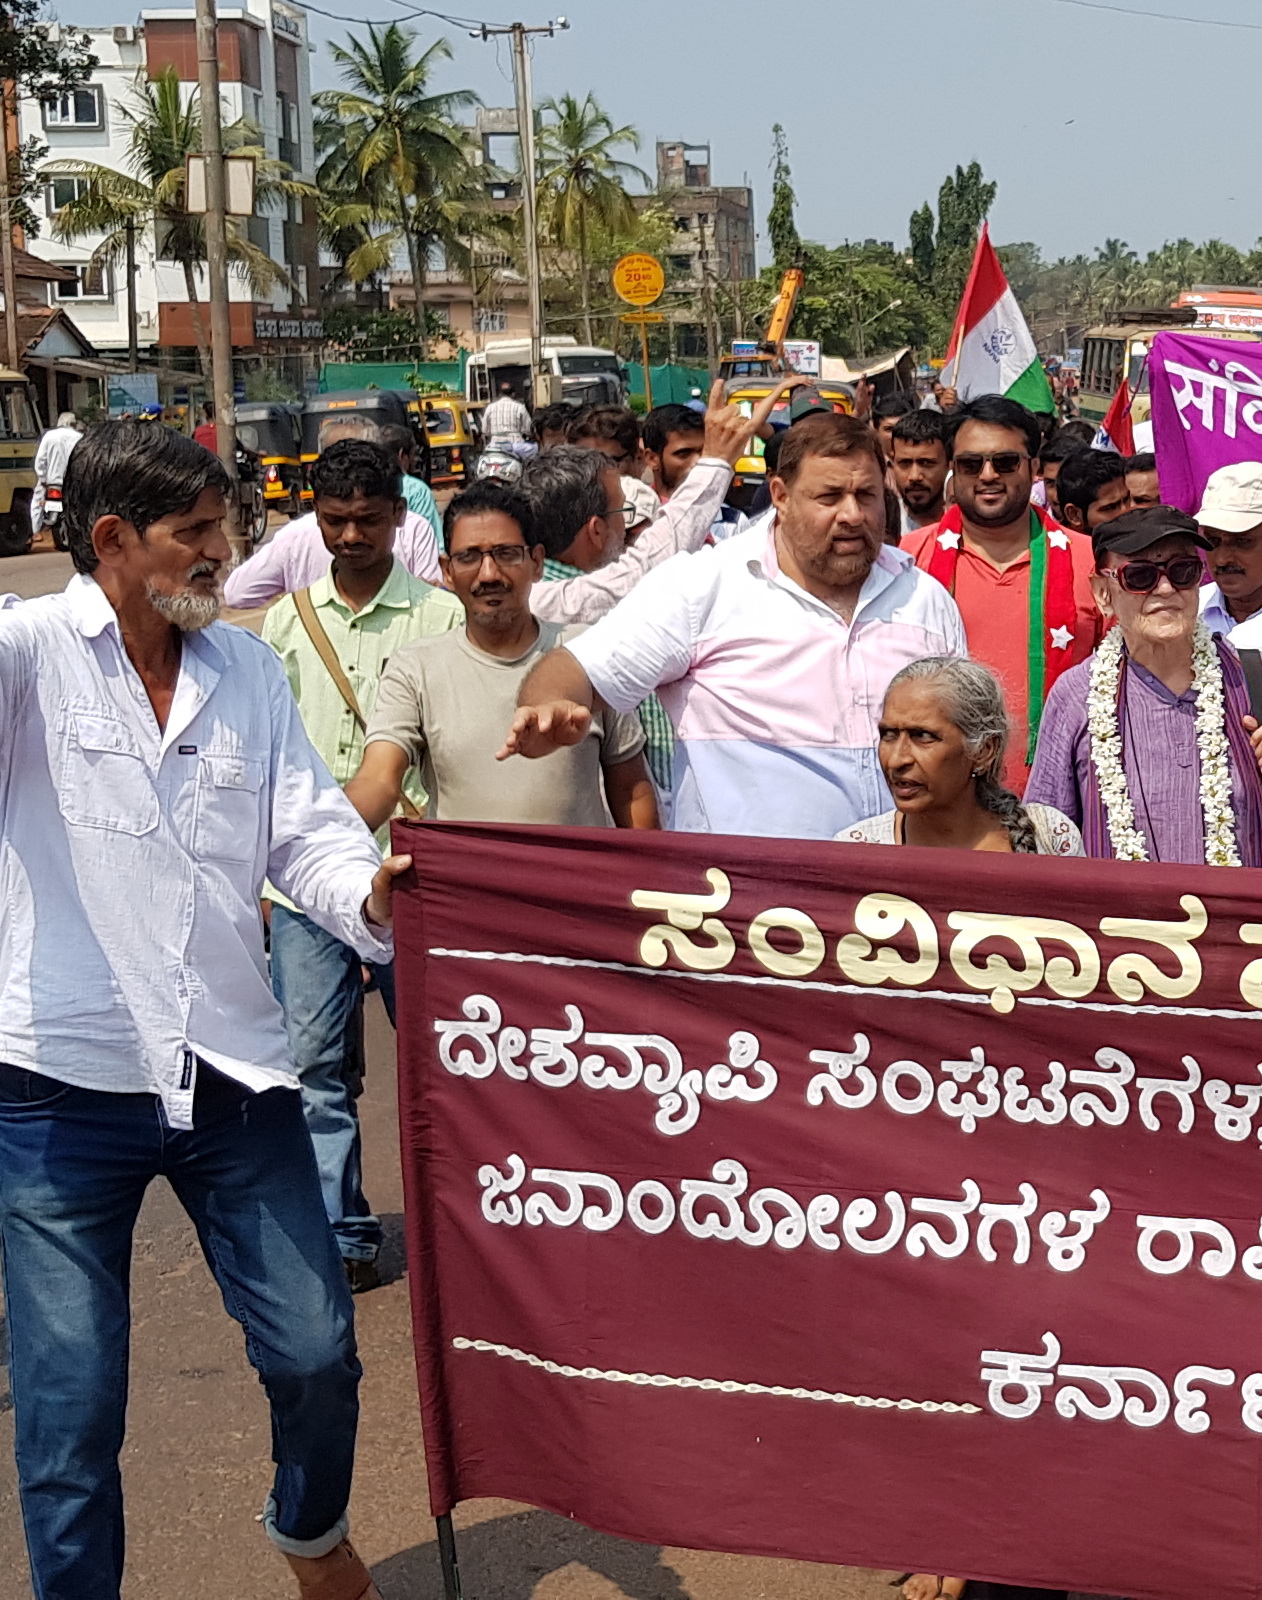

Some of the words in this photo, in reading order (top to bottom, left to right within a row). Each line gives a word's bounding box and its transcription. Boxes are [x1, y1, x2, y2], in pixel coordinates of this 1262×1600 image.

[630, 867, 1208, 1014] ಸಂವಿಧಾನ
[433, 993, 779, 1136] ದೇಶವ್ಯಾಪಿ
[477, 1153, 1111, 1273] ಜನಾಂದೋಲನಗಳ
